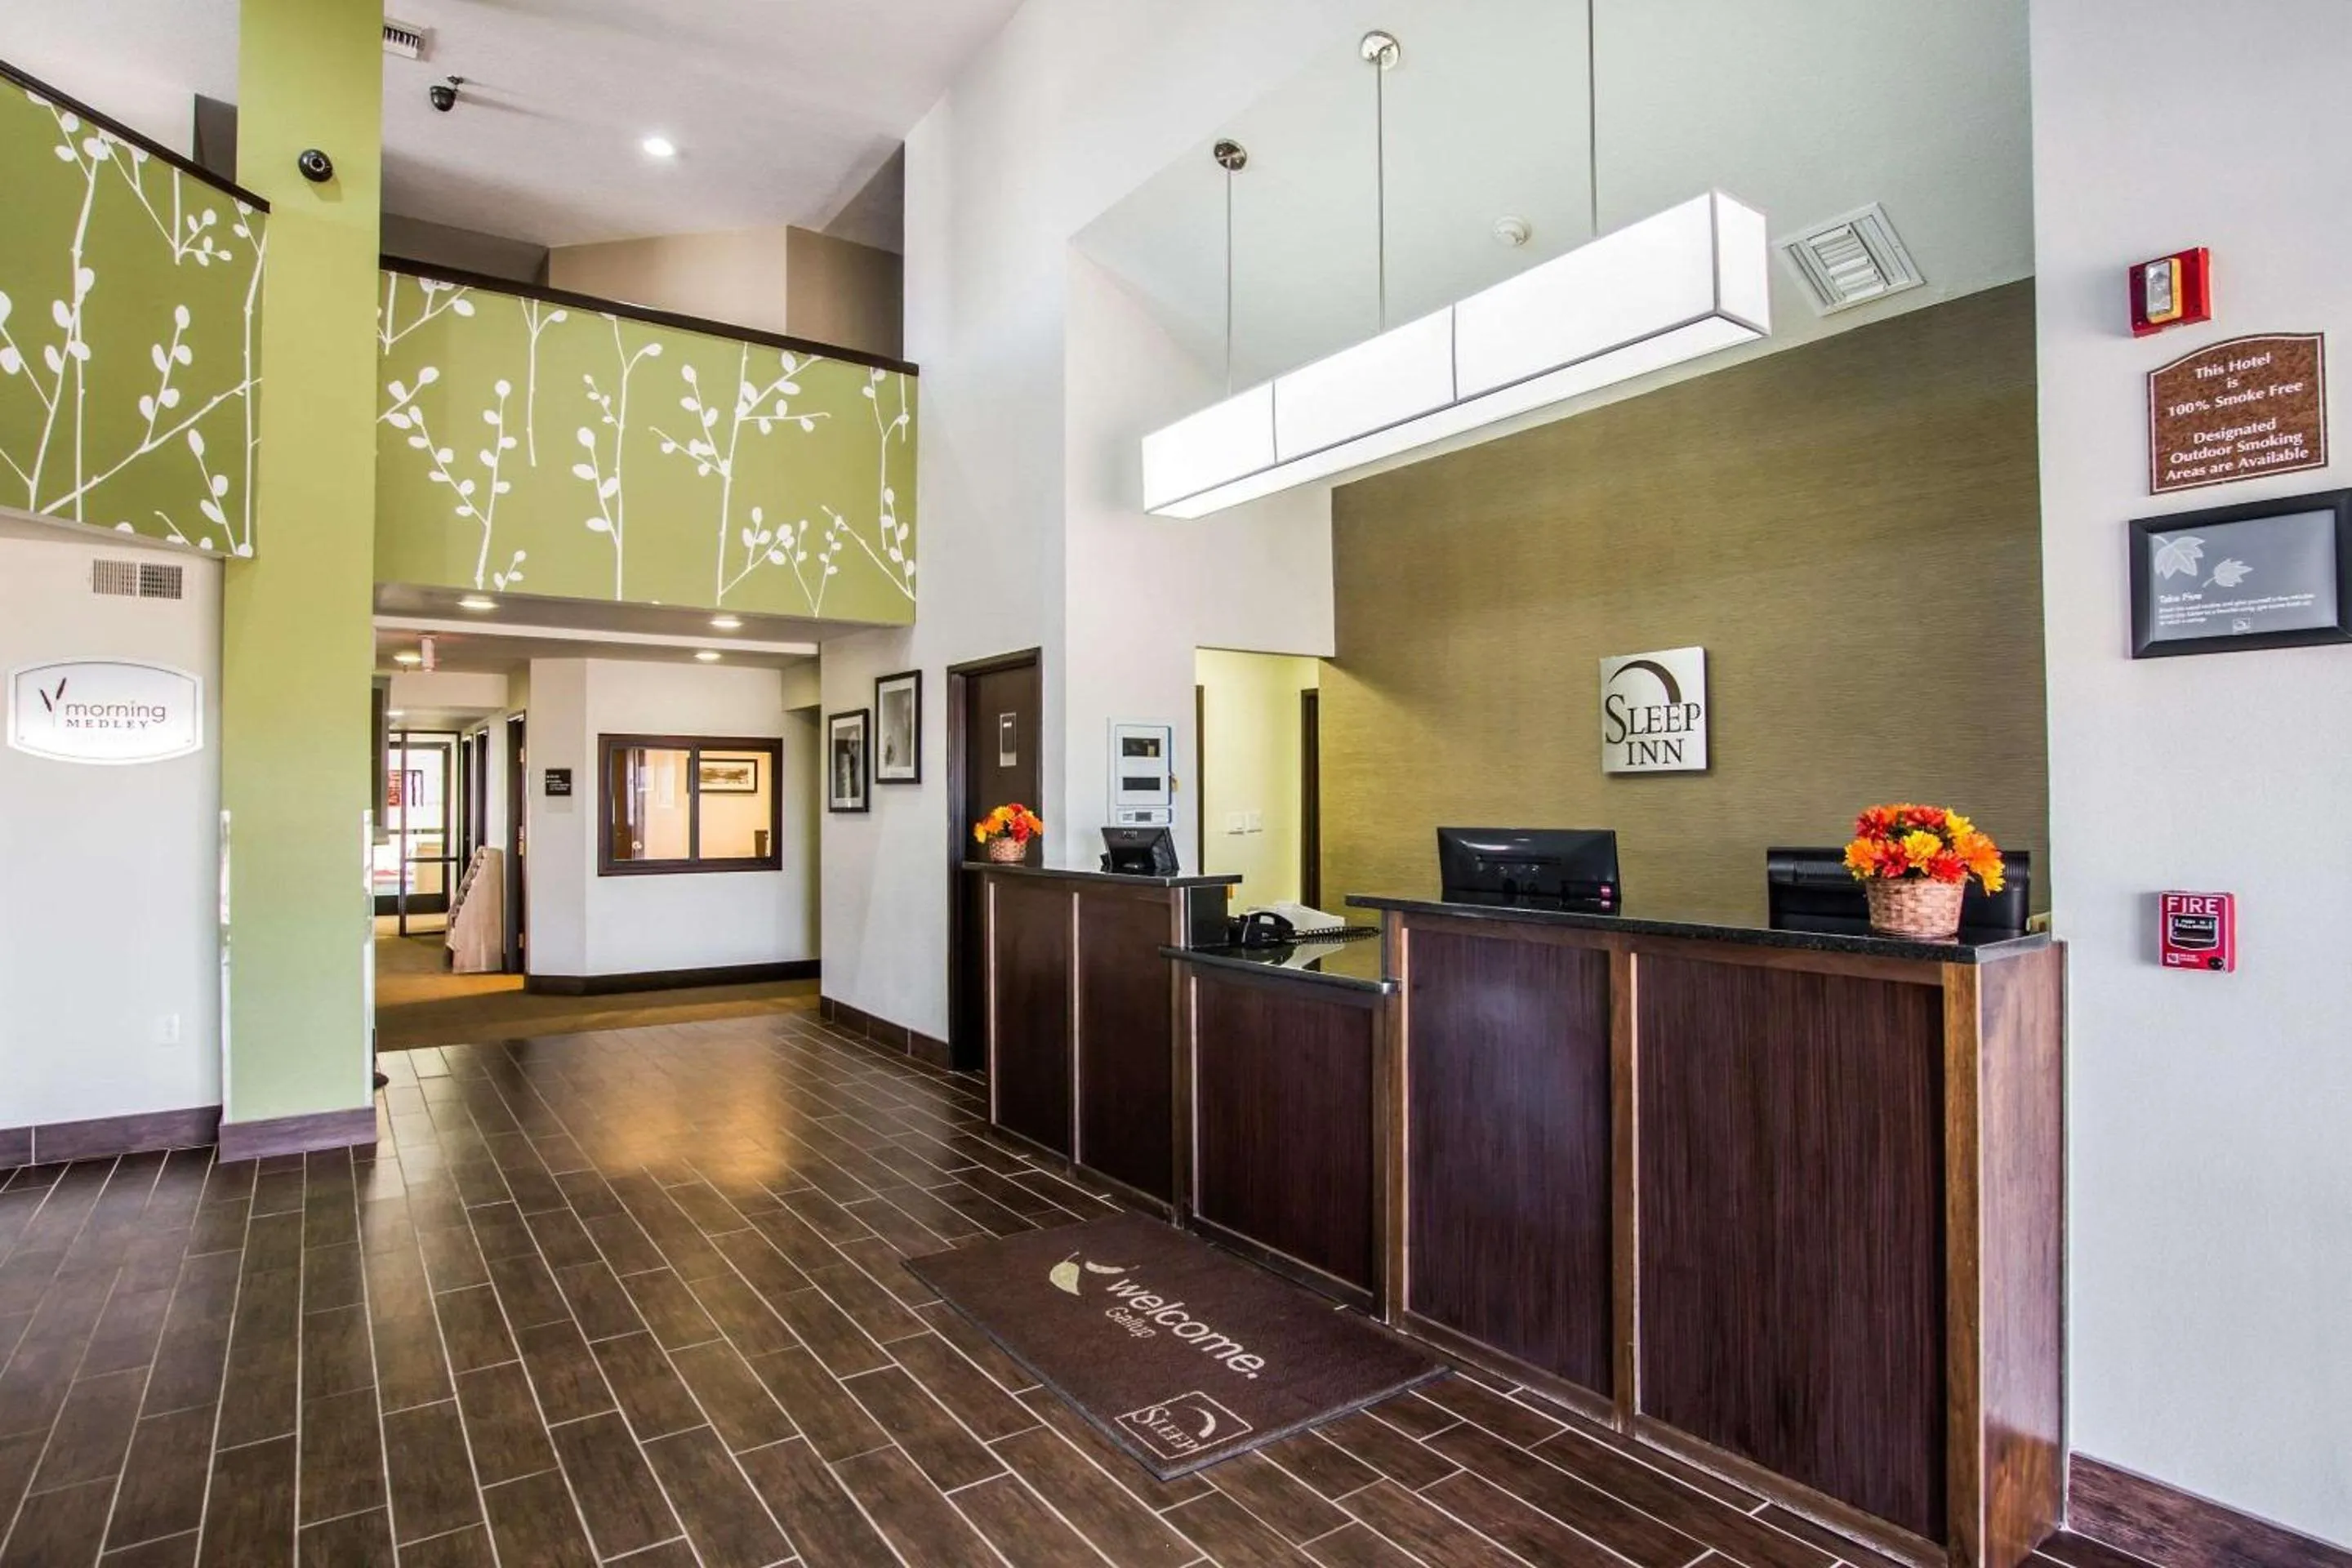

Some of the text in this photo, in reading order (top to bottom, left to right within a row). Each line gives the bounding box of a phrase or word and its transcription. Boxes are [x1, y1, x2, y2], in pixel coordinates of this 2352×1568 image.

[2194, 353, 2271, 380] This Hotel
[2227, 377, 2239, 388] is
[2168, 381, 2304, 416] 100% Smoke Free
[2194, 418, 2276, 444] Designated
[2170, 432, 2303, 464] Outdoor Smoking
[2166, 448, 2310, 481] Areas are Available
[65, 700, 166, 723] morning
[66, 718, 149, 728] MEDLEY
[1606, 693, 1701, 744] SLEEP
[1626, 738, 1685, 766] INN
[2167, 896, 2219, 915] FIRE
[1105, 1307, 1156, 1339] Gallup
[1106, 1278, 1266, 1379] welcome.
[1130, 1405, 1200, 1452] SLEEP
